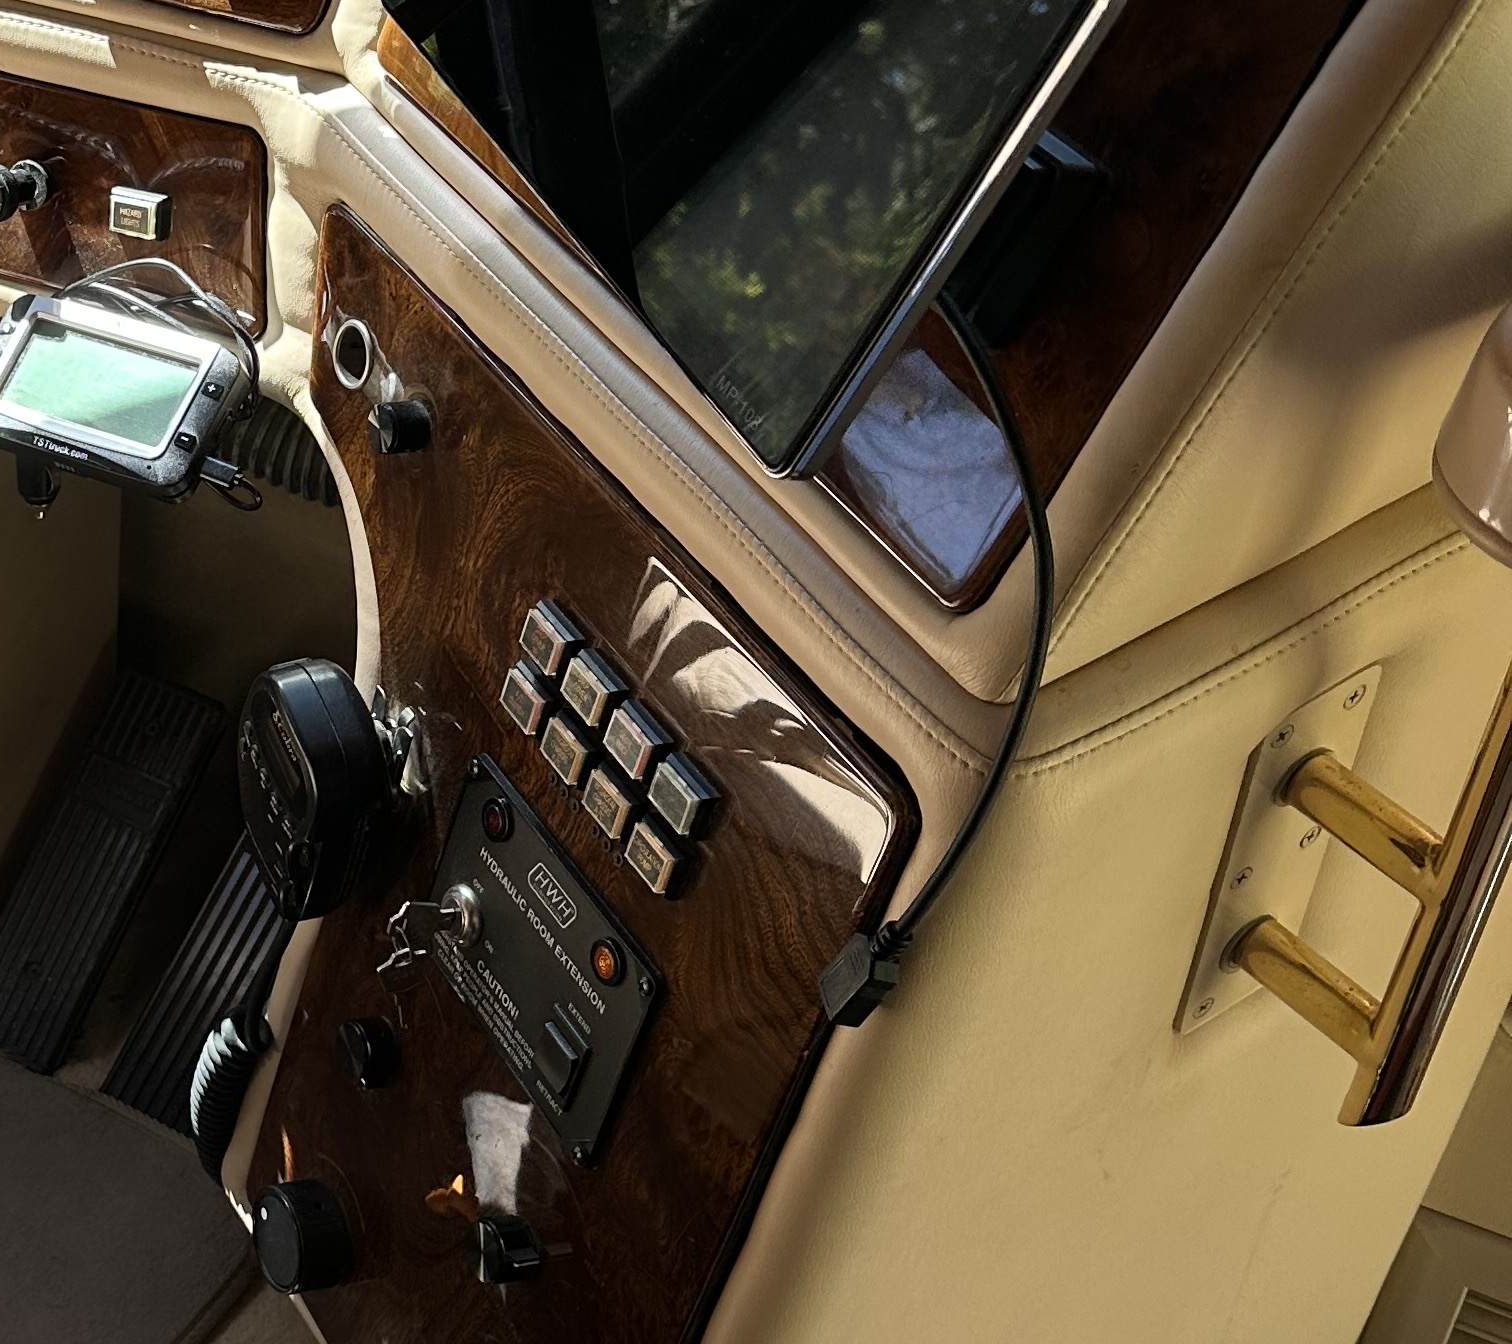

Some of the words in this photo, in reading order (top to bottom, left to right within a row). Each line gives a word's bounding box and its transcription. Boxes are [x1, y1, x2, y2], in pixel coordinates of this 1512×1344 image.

[534, 869, 573, 919] HWH
[479, 846, 528, 912] HYDRAULIC
[526, 907, 555, 948] ROOM
[554, 944, 606, 1015] EXTENSION
[484, 939, 495, 954] ON
[476, 959, 520, 1021] CAUTION!
[567, 1002, 592, 1035] EXTEND
[535, 1079, 564, 1117] RETRACT
